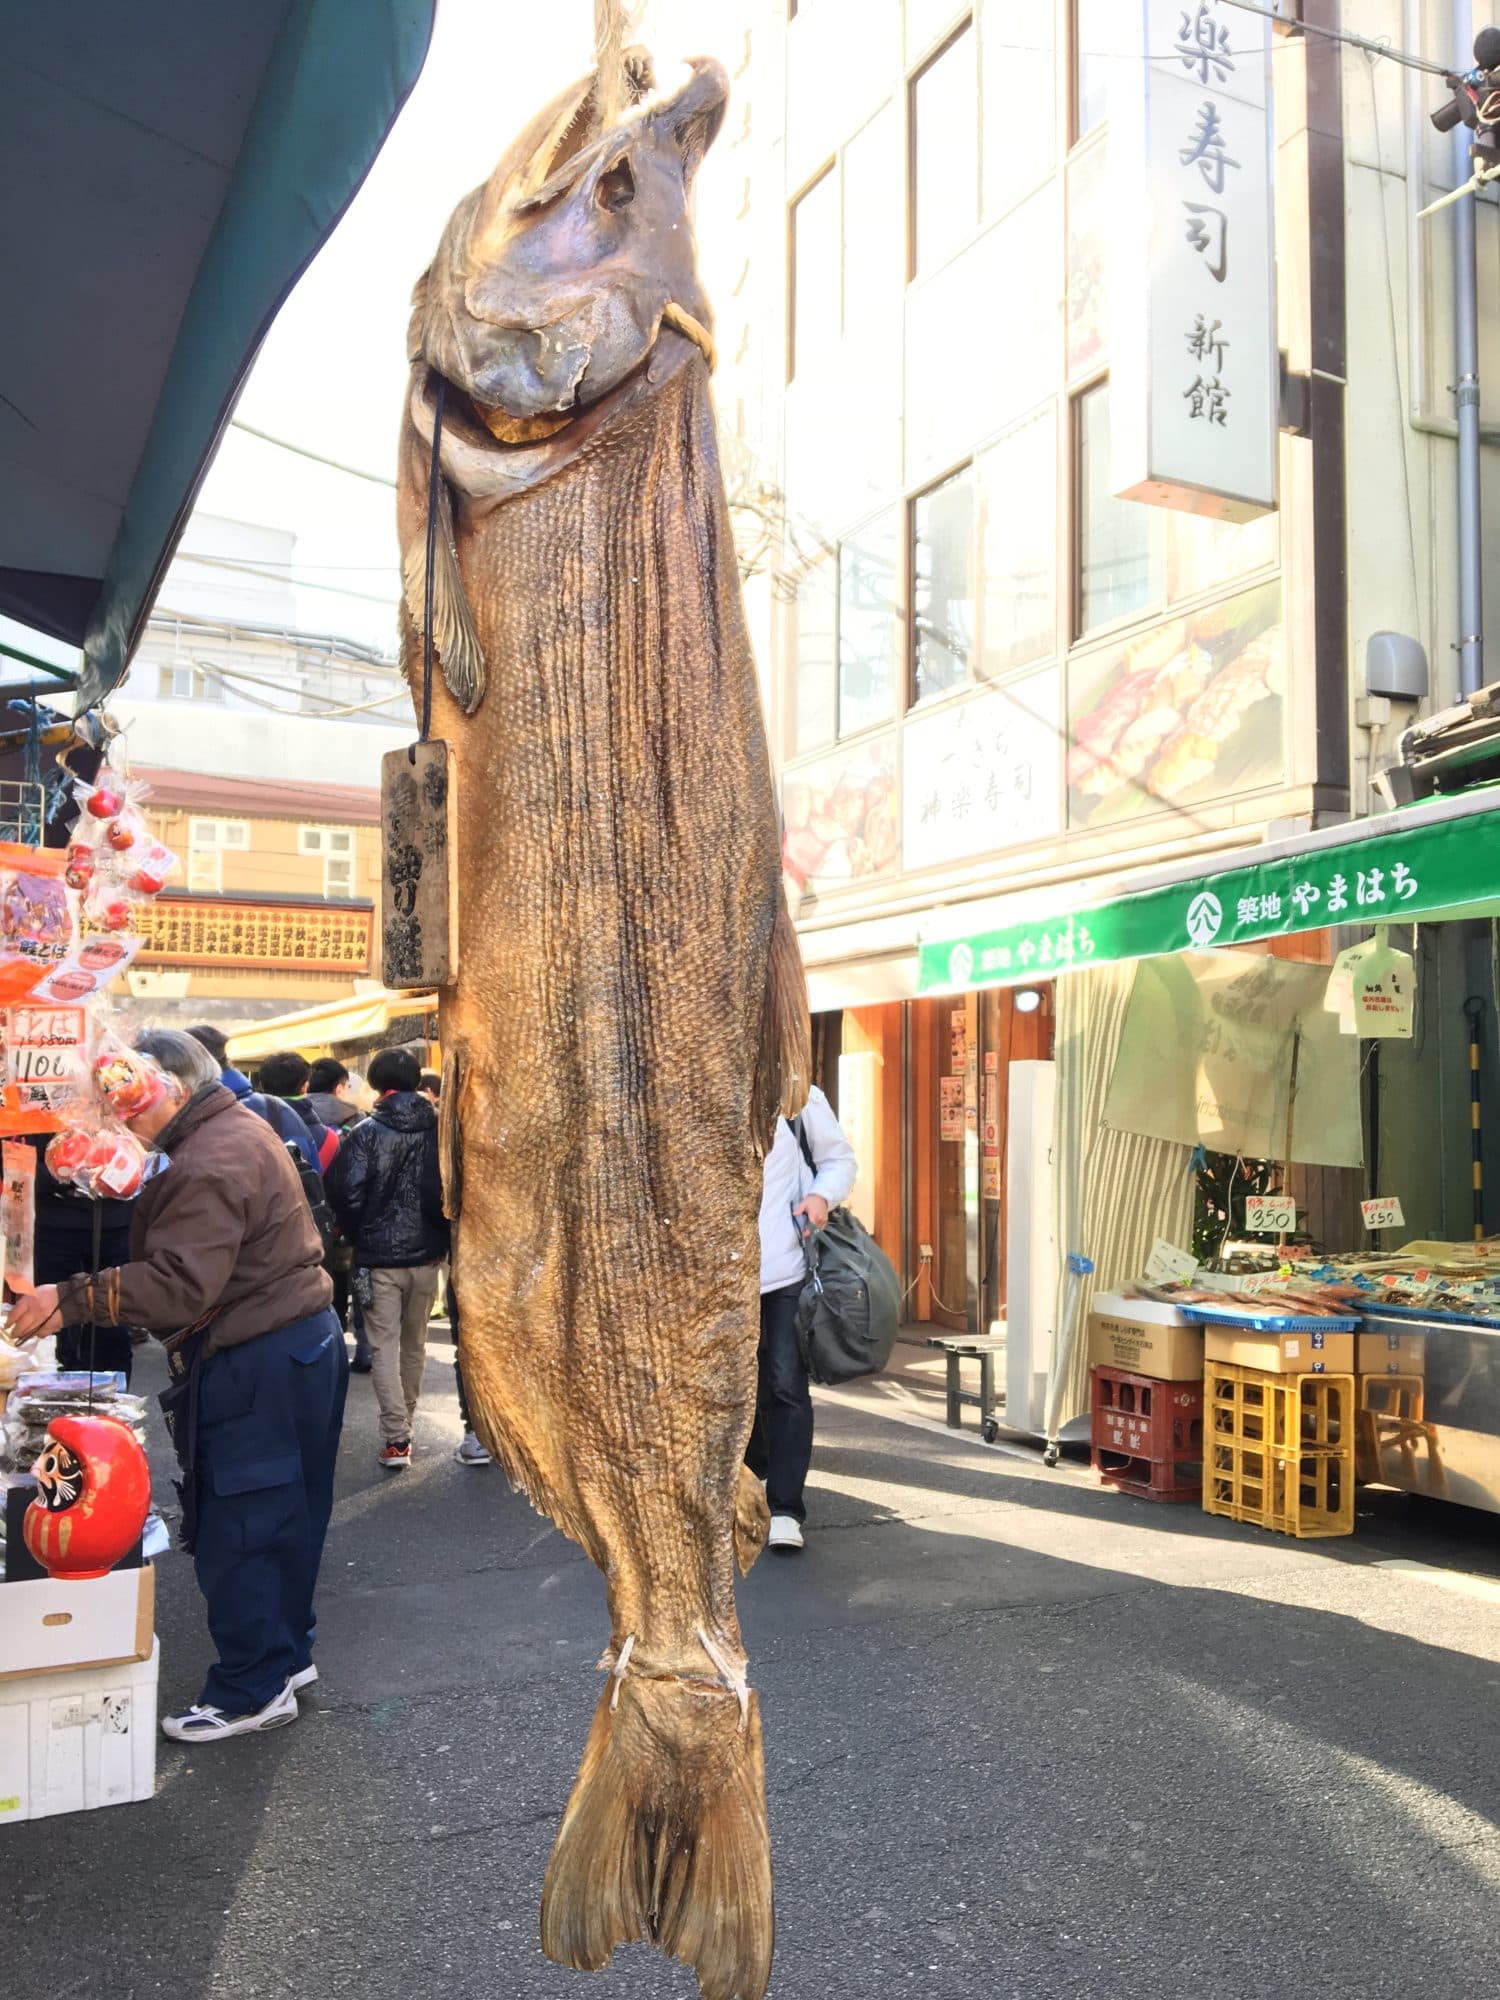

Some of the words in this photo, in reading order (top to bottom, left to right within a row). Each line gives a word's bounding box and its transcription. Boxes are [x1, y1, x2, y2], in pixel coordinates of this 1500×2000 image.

[1236, 891, 1282, 926] 築地
[1291, 861, 1418, 916] やまはち
[1252, 1208, 1290, 1229] 350
